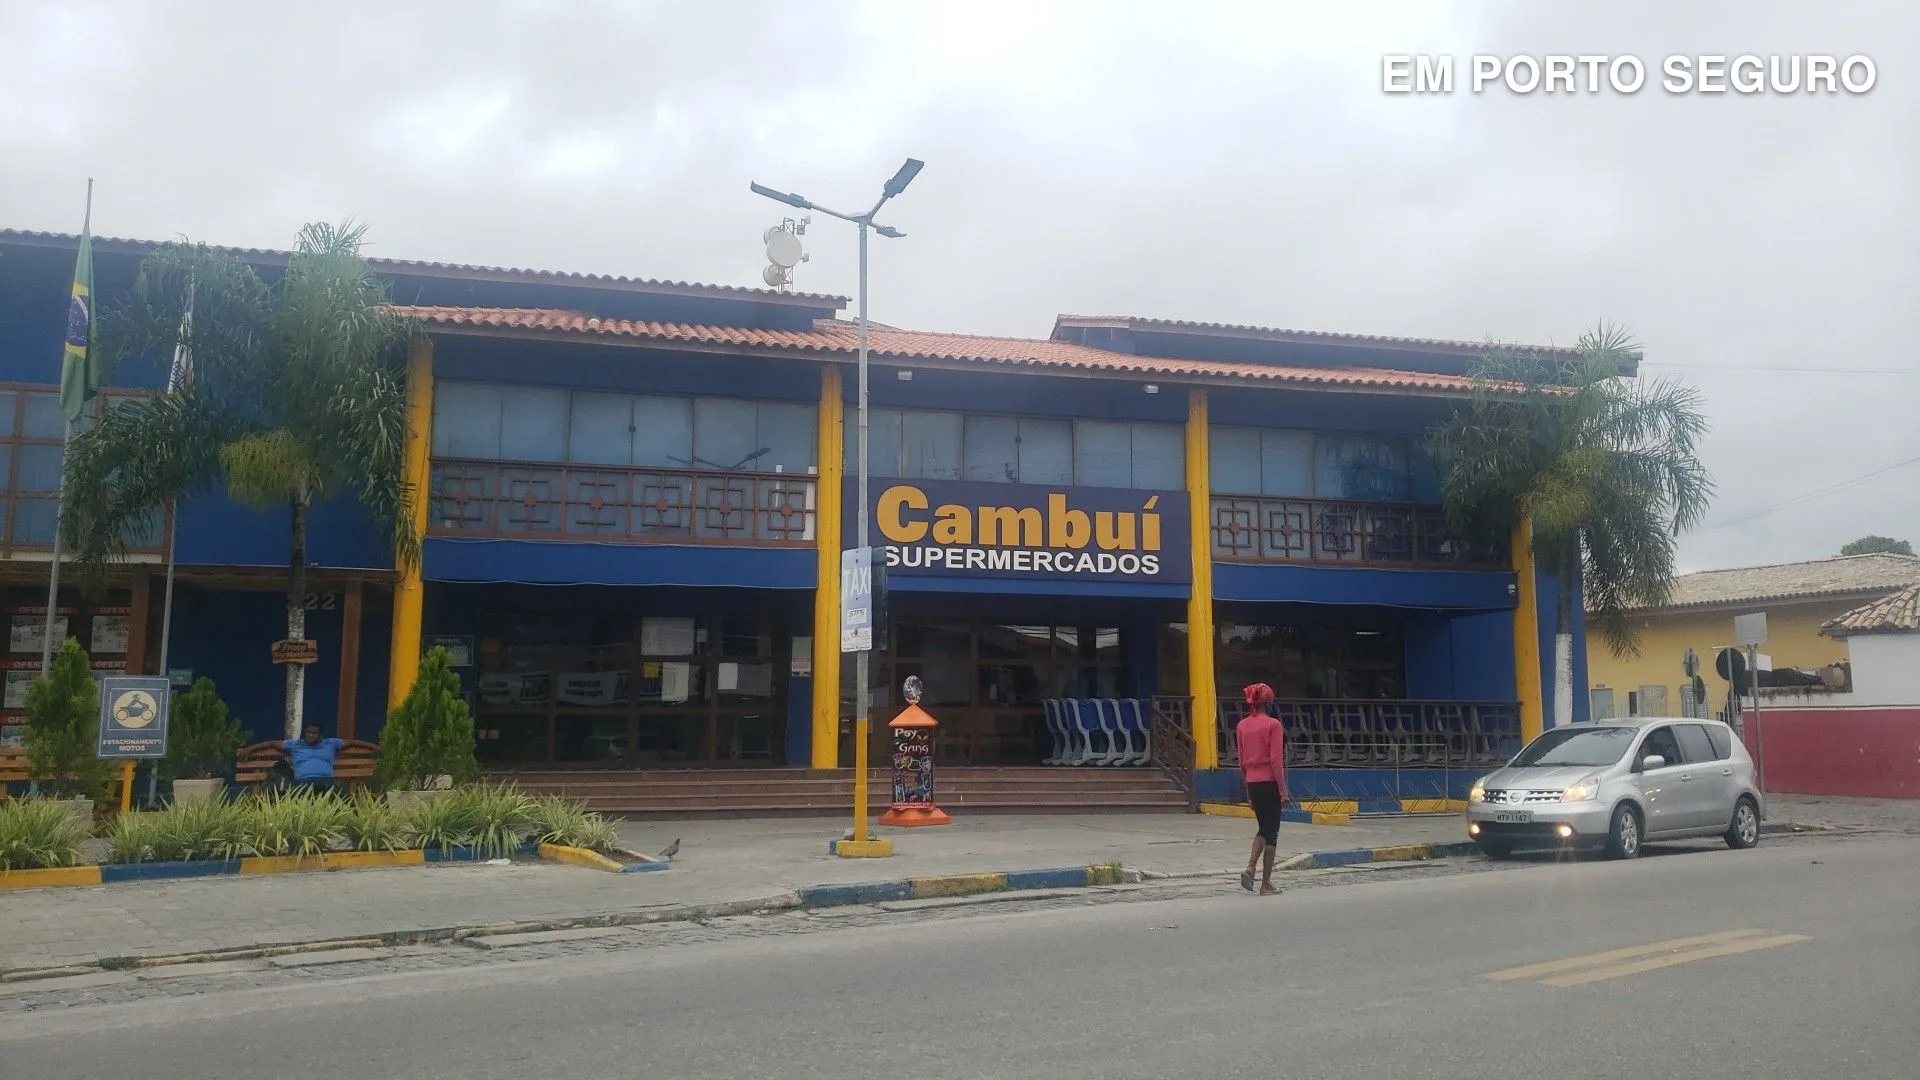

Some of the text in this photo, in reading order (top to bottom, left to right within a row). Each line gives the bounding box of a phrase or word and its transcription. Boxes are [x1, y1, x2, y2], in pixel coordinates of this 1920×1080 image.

[876, 485, 1161, 551] Cambuí
[885, 545, 1161, 575] SUPERMERCADOS
[894, 728, 917, 740] Psy
